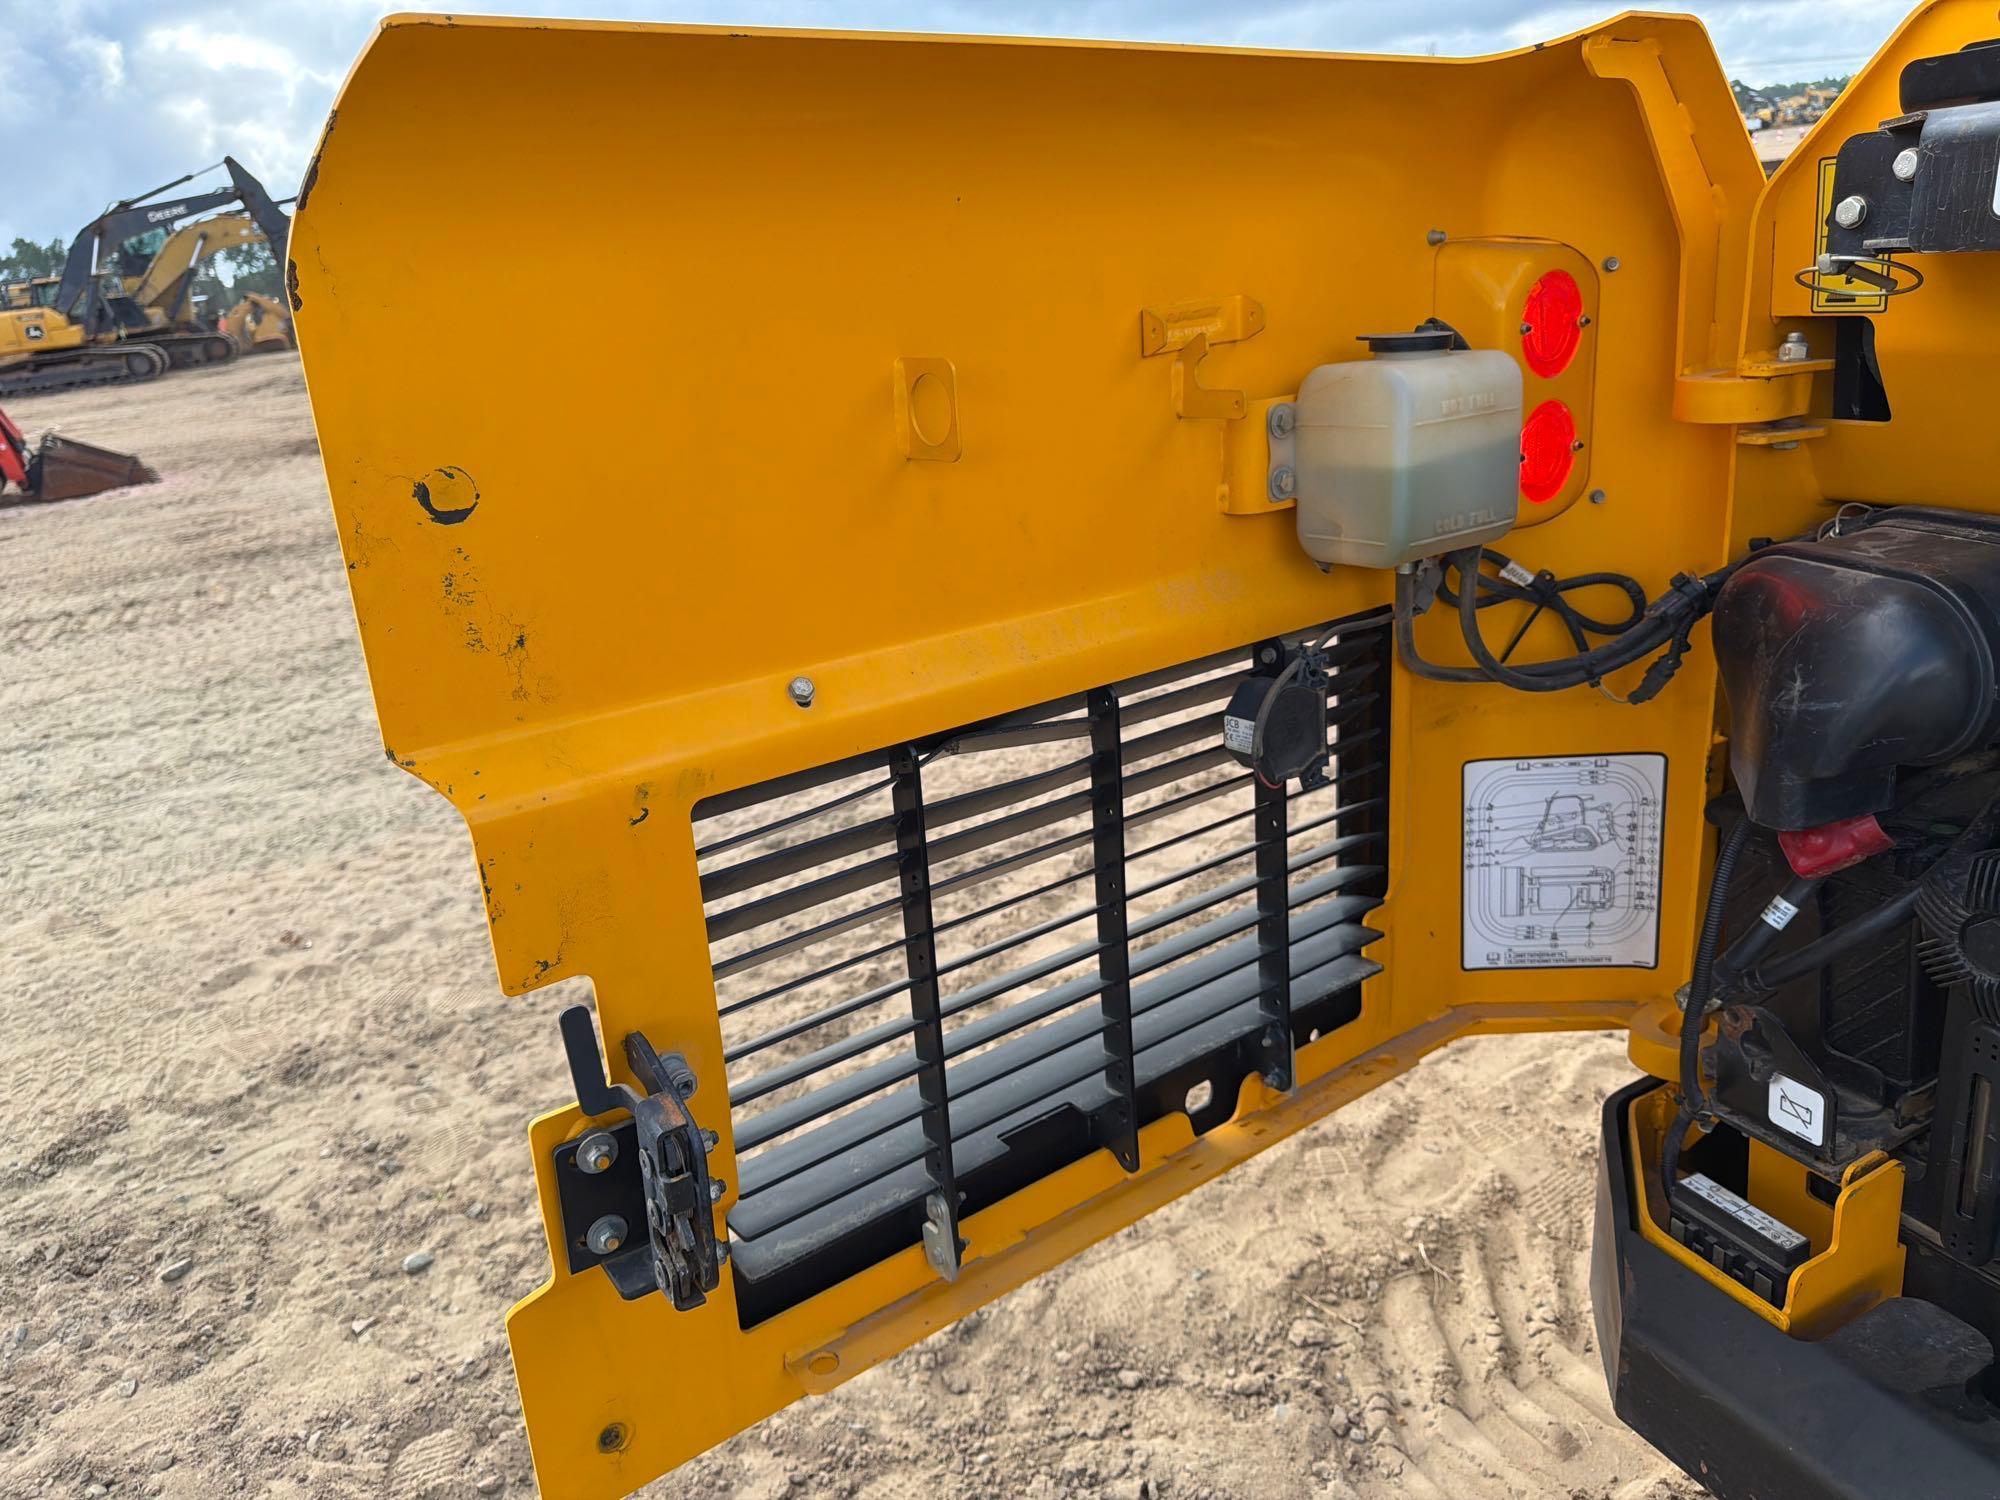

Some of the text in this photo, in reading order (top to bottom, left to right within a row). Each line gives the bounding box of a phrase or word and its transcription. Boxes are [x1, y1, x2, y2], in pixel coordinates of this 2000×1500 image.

[148, 205, 187, 223] DEERE
[1435, 507, 1497, 534] COLD FULL
[1226, 717, 1240, 729] JCB
